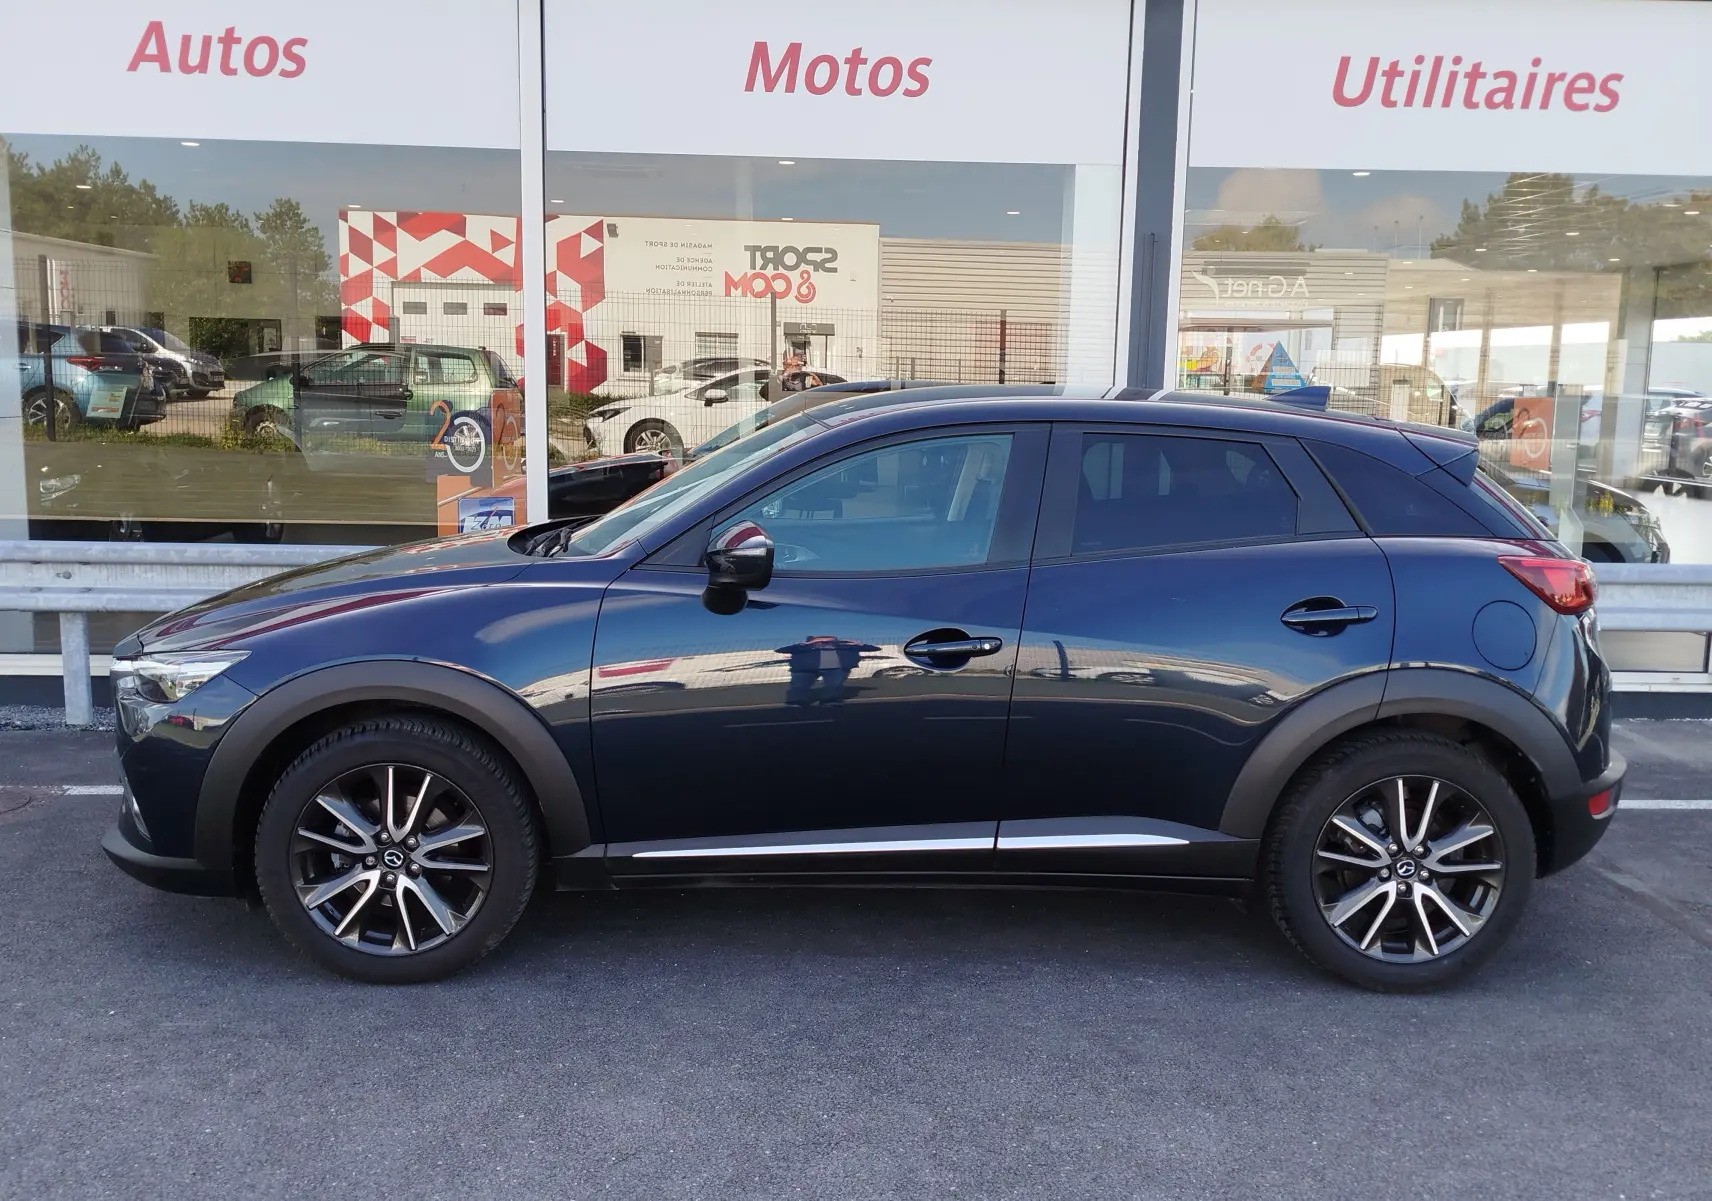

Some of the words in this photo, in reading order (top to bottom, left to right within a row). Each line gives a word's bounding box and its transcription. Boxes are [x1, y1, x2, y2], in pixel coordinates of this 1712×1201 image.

[128, 21, 307, 79] Autos
[745, 41, 932, 98] Motos
[1333, 54, 1623, 112] Utilitaires
